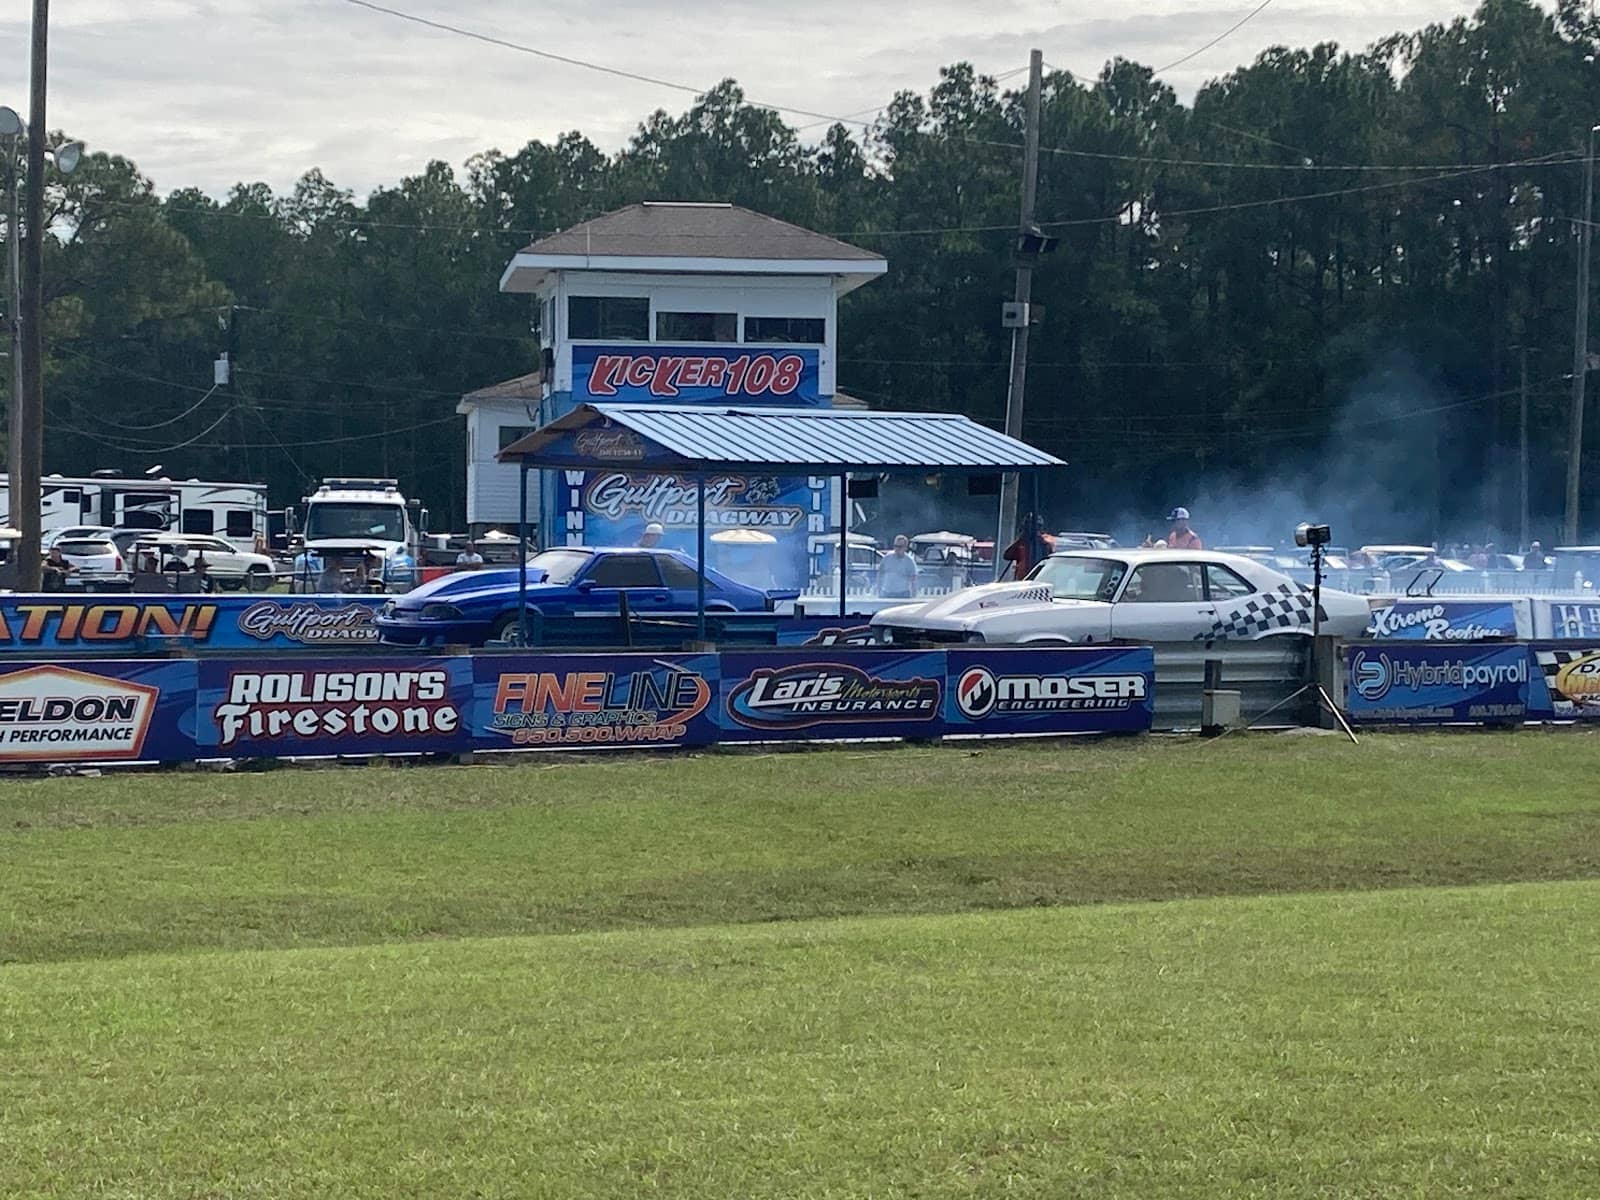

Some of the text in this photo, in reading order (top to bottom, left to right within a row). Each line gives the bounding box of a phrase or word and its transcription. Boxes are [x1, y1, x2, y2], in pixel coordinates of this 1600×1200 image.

[588, 355, 803, 396] KICKER108
[592, 474, 740, 516] Gulfport
[666, 509, 797, 525] DRAGWAY
[0, 606, 217, 640] TION!
[245, 606, 364, 633] Gulfport
[1367, 605, 1445, 639] Xtreme
[231, 671, 447, 704] ROLISON'S
[997, 675, 1146, 700] MOSER
[1393, 659, 1527, 690] Hybridpayroll
[748, 672, 845, 708] Laris
[998, 699, 1129, 709] ENGINEERING
[493, 711, 658, 728] SIGNS & GRAPHICS
[792, 699, 933, 712] INSURANCE
[9, 727, 134, 743] PERFORMANCE
[216, 703, 458, 744] Firestone
[512, 724, 688, 744] 850.500.WRAP
